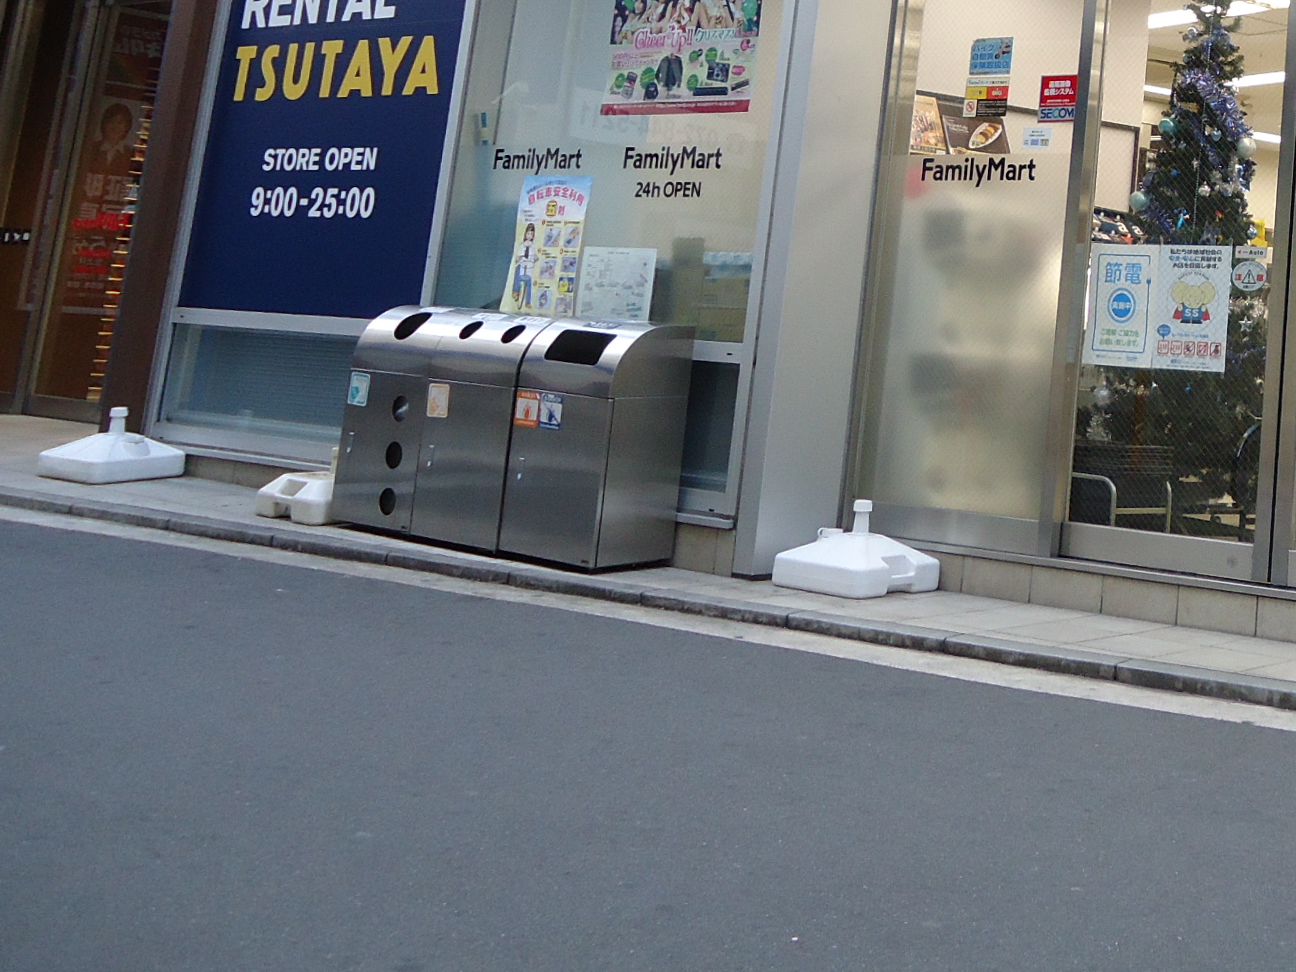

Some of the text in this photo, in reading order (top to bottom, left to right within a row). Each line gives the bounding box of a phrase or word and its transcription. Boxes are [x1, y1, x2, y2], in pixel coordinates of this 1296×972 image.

[634, 28, 666, 51] Cheer
[973, 44, 995, 52] バイク
[233, 35, 439, 102] TSUTAYA
[1040, 107, 1075, 119] SECOM
[262, 147, 378, 171] STORE OPEN
[493, 147, 582, 176] FamilyMart
[623, 146, 722, 176] FamilyMart
[921, 157, 1036, 188] FamilyMart
[634, 181, 702, 198] 24h OPEN
[250, 186, 375, 218] 9:00-25:00
[1104, 262, 1143, 285] 節電
[1184, 308, 1199, 317] SS
